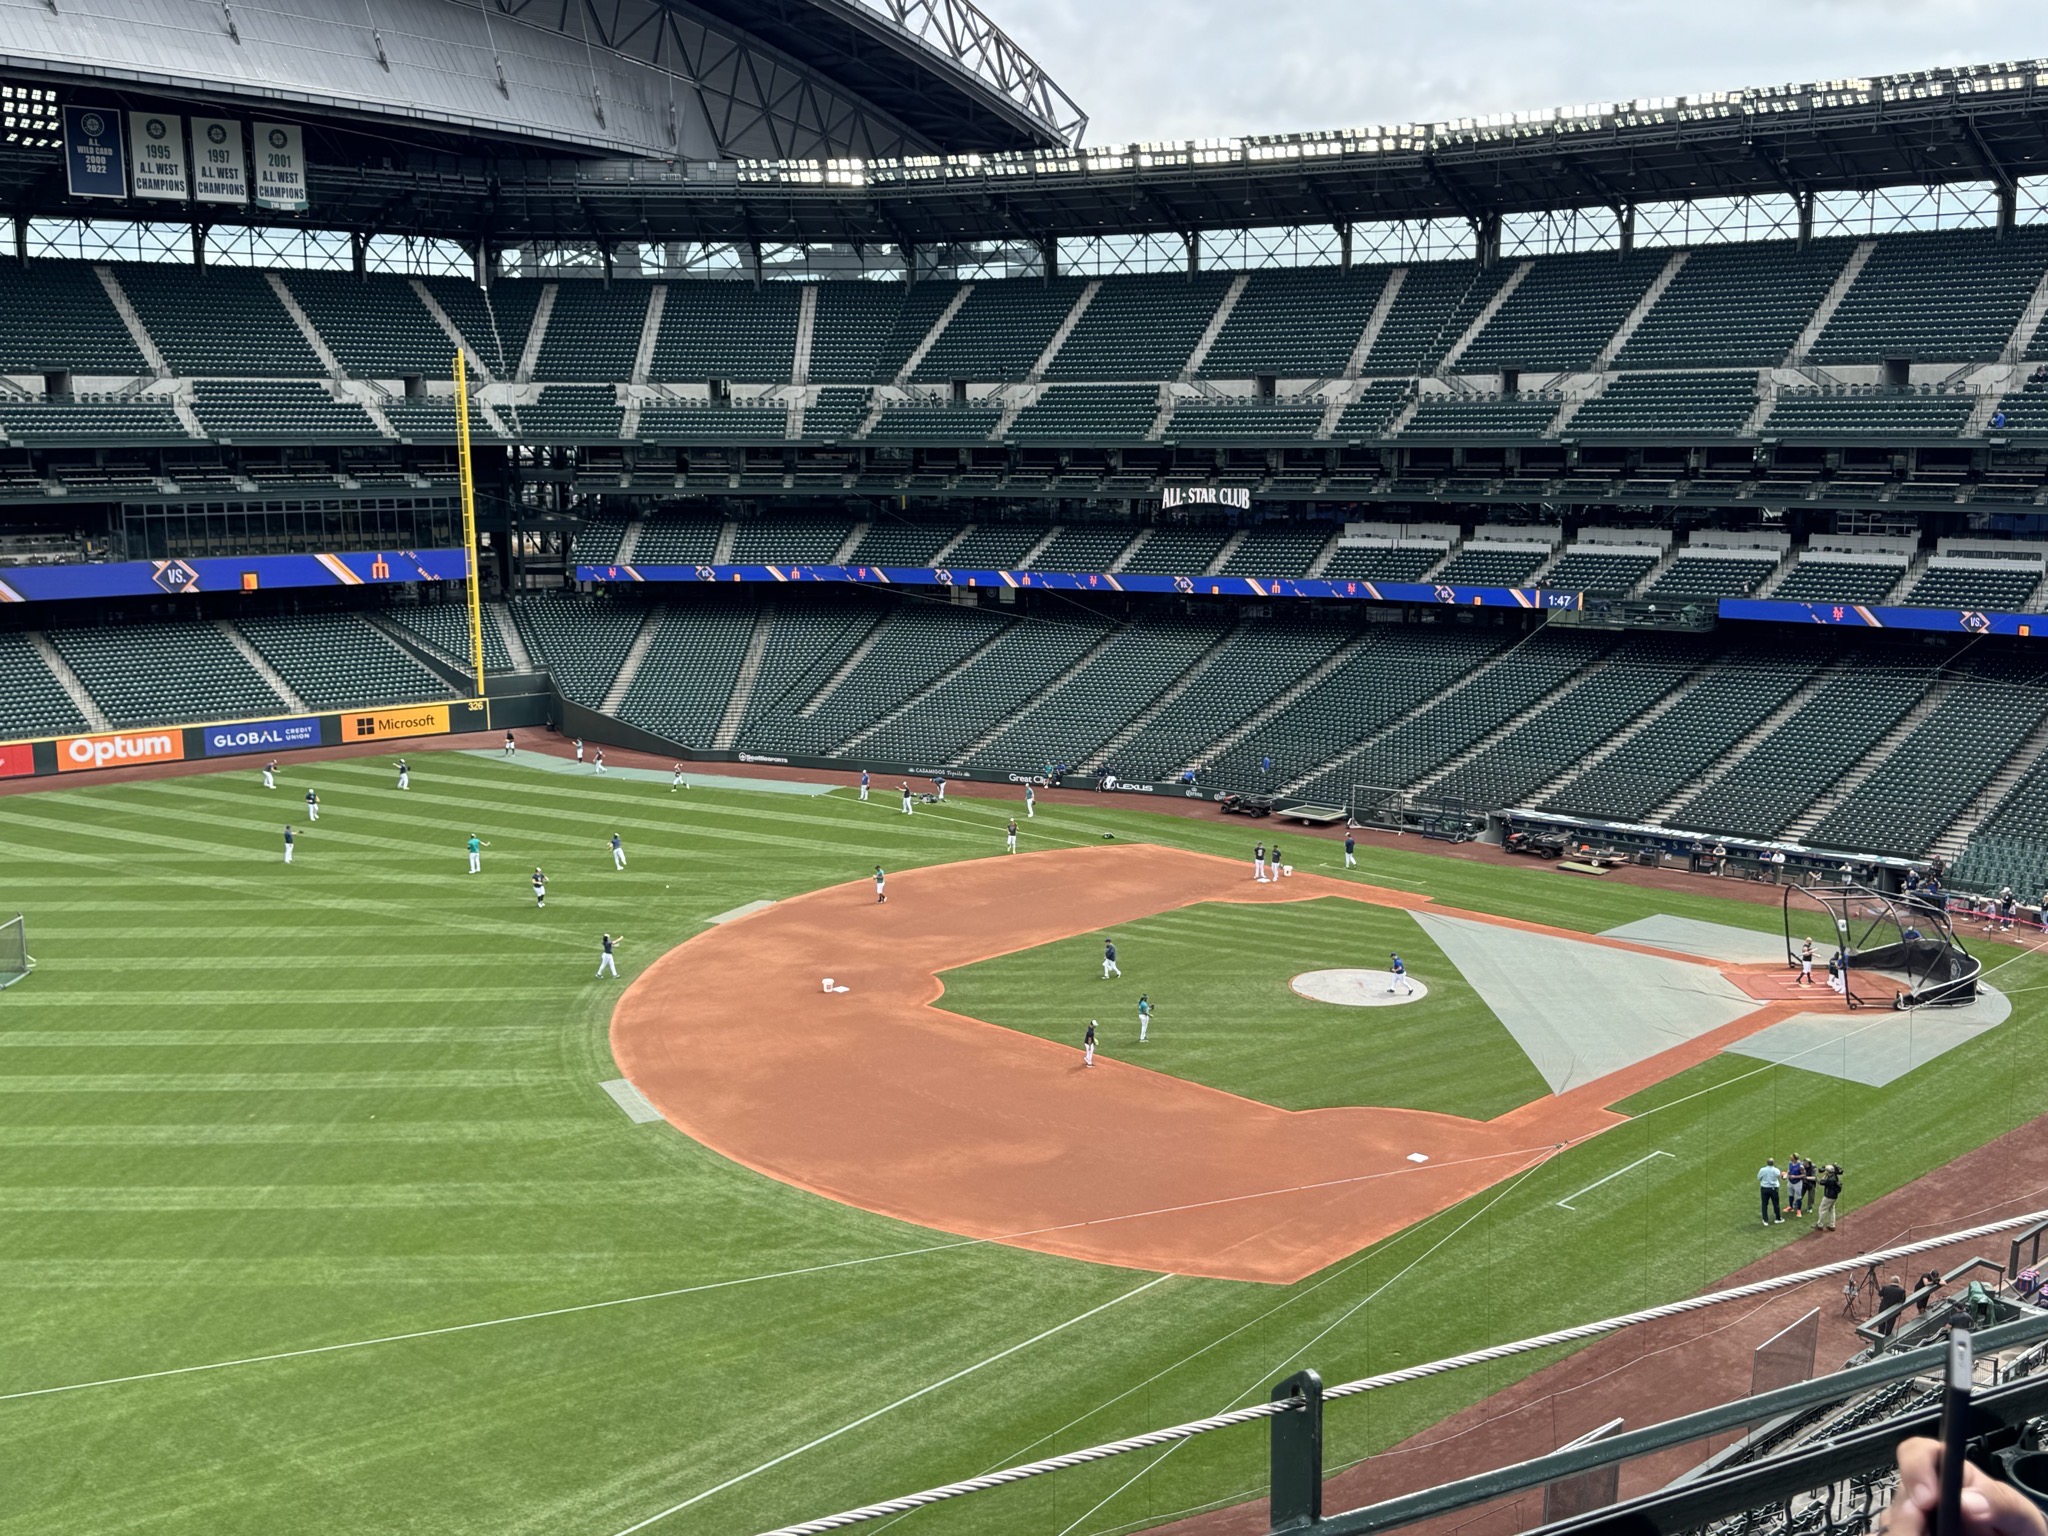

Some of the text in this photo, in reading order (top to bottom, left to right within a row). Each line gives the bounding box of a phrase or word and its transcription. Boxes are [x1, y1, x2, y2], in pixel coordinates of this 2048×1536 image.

[77, 145, 113, 156] WILD CARD
[146, 144, 171, 159] 1995
[207, 149, 230, 164] 1997
[86, 156, 106, 164] 2000
[268, 153, 291, 168] 2001
[86, 165, 107, 173] 2022
[140, 162, 178, 176] A.L. WEST
[201, 166, 238, 180] A.L. WEST
[263, 171, 298, 184] A.L. WEST
[136, 178, 185, 192] CHAMPIONS
[198, 181, 244, 196] CHAMPIONS
[259, 186, 304, 199] CHAMPIONS
[1220, 488, 1250, 509] CLUB
[167, 569, 187, 584] VS.
[1549, 595, 1571, 606] 1:47
[1970, 617, 1982, 627] VS.
[468, 701, 483, 711] 326
[378, 714, 435, 730] Microsoft
[285, 726, 312, 734] CREDIT
[214, 730, 283, 747] GLOBAL
[286, 733, 310, 741] UNION
[69, 735, 171, 767] Optum
[916, 767, 945, 775] CASAMIGOS
[1009, 774, 1032, 783] Great
[1116, 783, 1153, 792] LEXUS
[1185, 789, 1203, 798] Corona
